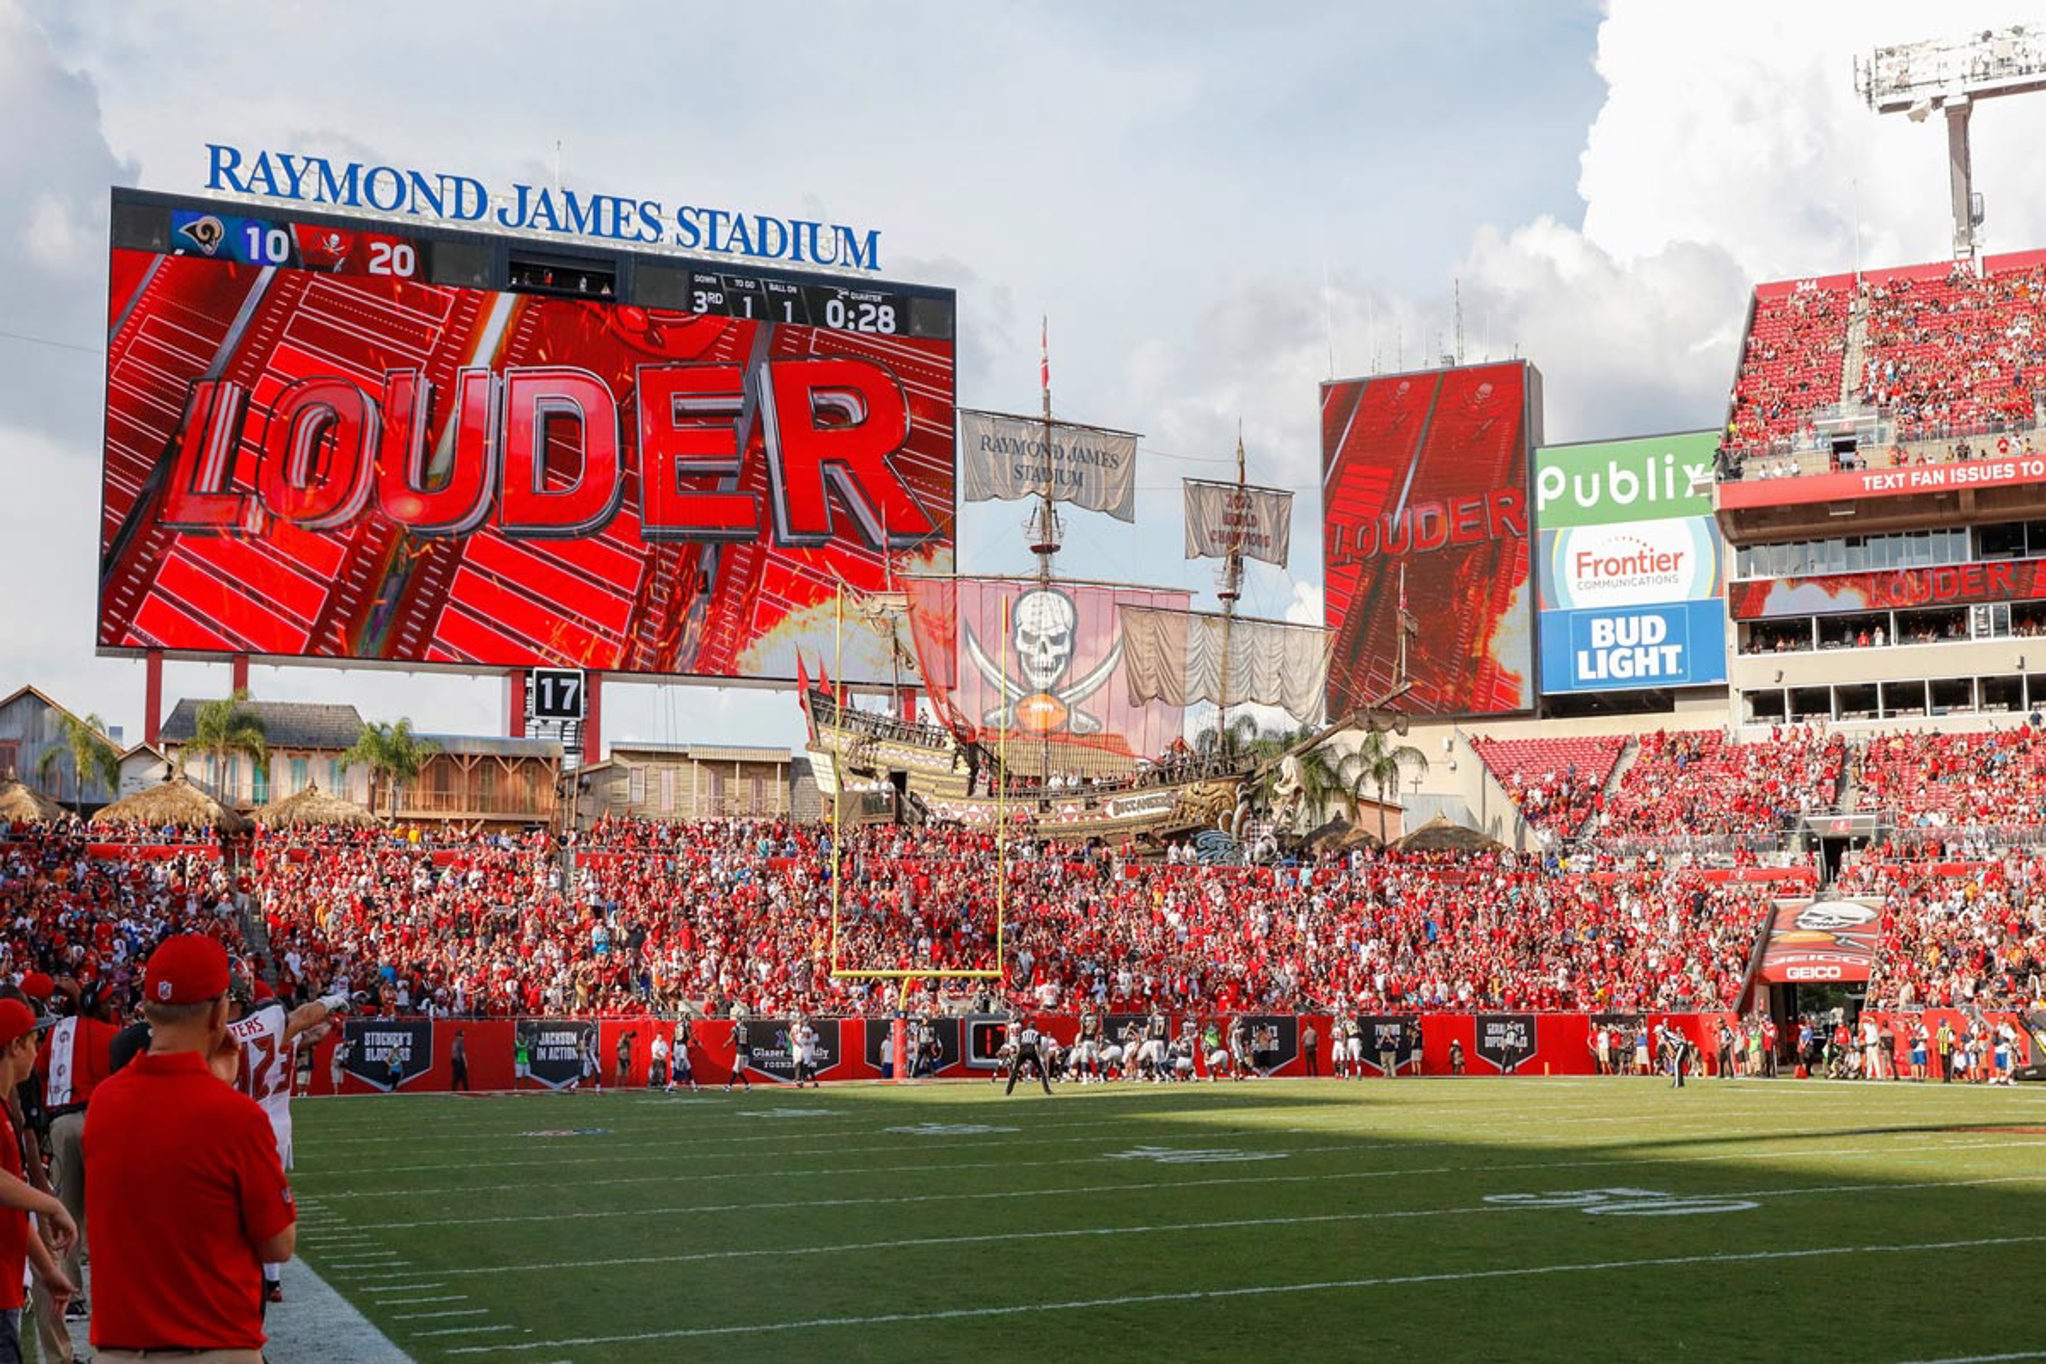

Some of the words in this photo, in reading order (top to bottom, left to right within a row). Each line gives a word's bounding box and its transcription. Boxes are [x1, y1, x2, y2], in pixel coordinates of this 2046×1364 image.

[204, 143, 488, 221] RAYMOND
[497, 184, 664, 243] JAMES
[676, 205, 882, 271] STADIUM
[246, 226, 290, 263] 10
[368, 241, 415, 278] 20
[694, 275, 717, 285] DOWN
[734, 279, 744, 287] TO
[745, 280, 756, 289] GO
[768, 283, 786, 293] BALL
[787, 285, 798, 294] ON
[1796, 280, 1818, 292] 344
[693, 291, 724, 314] 3RD
[742, 296, 753, 319] 1
[850, 291, 883, 303] QUARTER
[783, 301, 793, 323] 1
[825, 299, 896, 334] 0:28
[156, 357, 943, 548] LOUDER
[980, 434, 1064, 460] RAYMOND
[1067, 447, 1120, 469] JAMES
[1013, 464, 1084, 487] STADIUM
[1861, 473, 1906, 491] TEXT
[1911, 470, 1945, 487] FAN
[1950, 463, 2015, 483] ISSUES
[2020, 460, 2045, 477] TO
[1325, 488, 1529, 566] LOUDER
[1576, 547, 1684, 579] Frontier
[1576, 574, 1679, 591] COMMUNICATIONS
[1866, 561, 2016, 609] LOUDER
[1591, 614, 1667, 649] BUD
[540, 677, 580, 711] 17
[1786, 965, 1841, 979] GEICO
[538, 1031, 577, 1046] JACKSON
[536, 1046, 547, 1060] IN
[548, 1046, 579, 1060] ACTION
